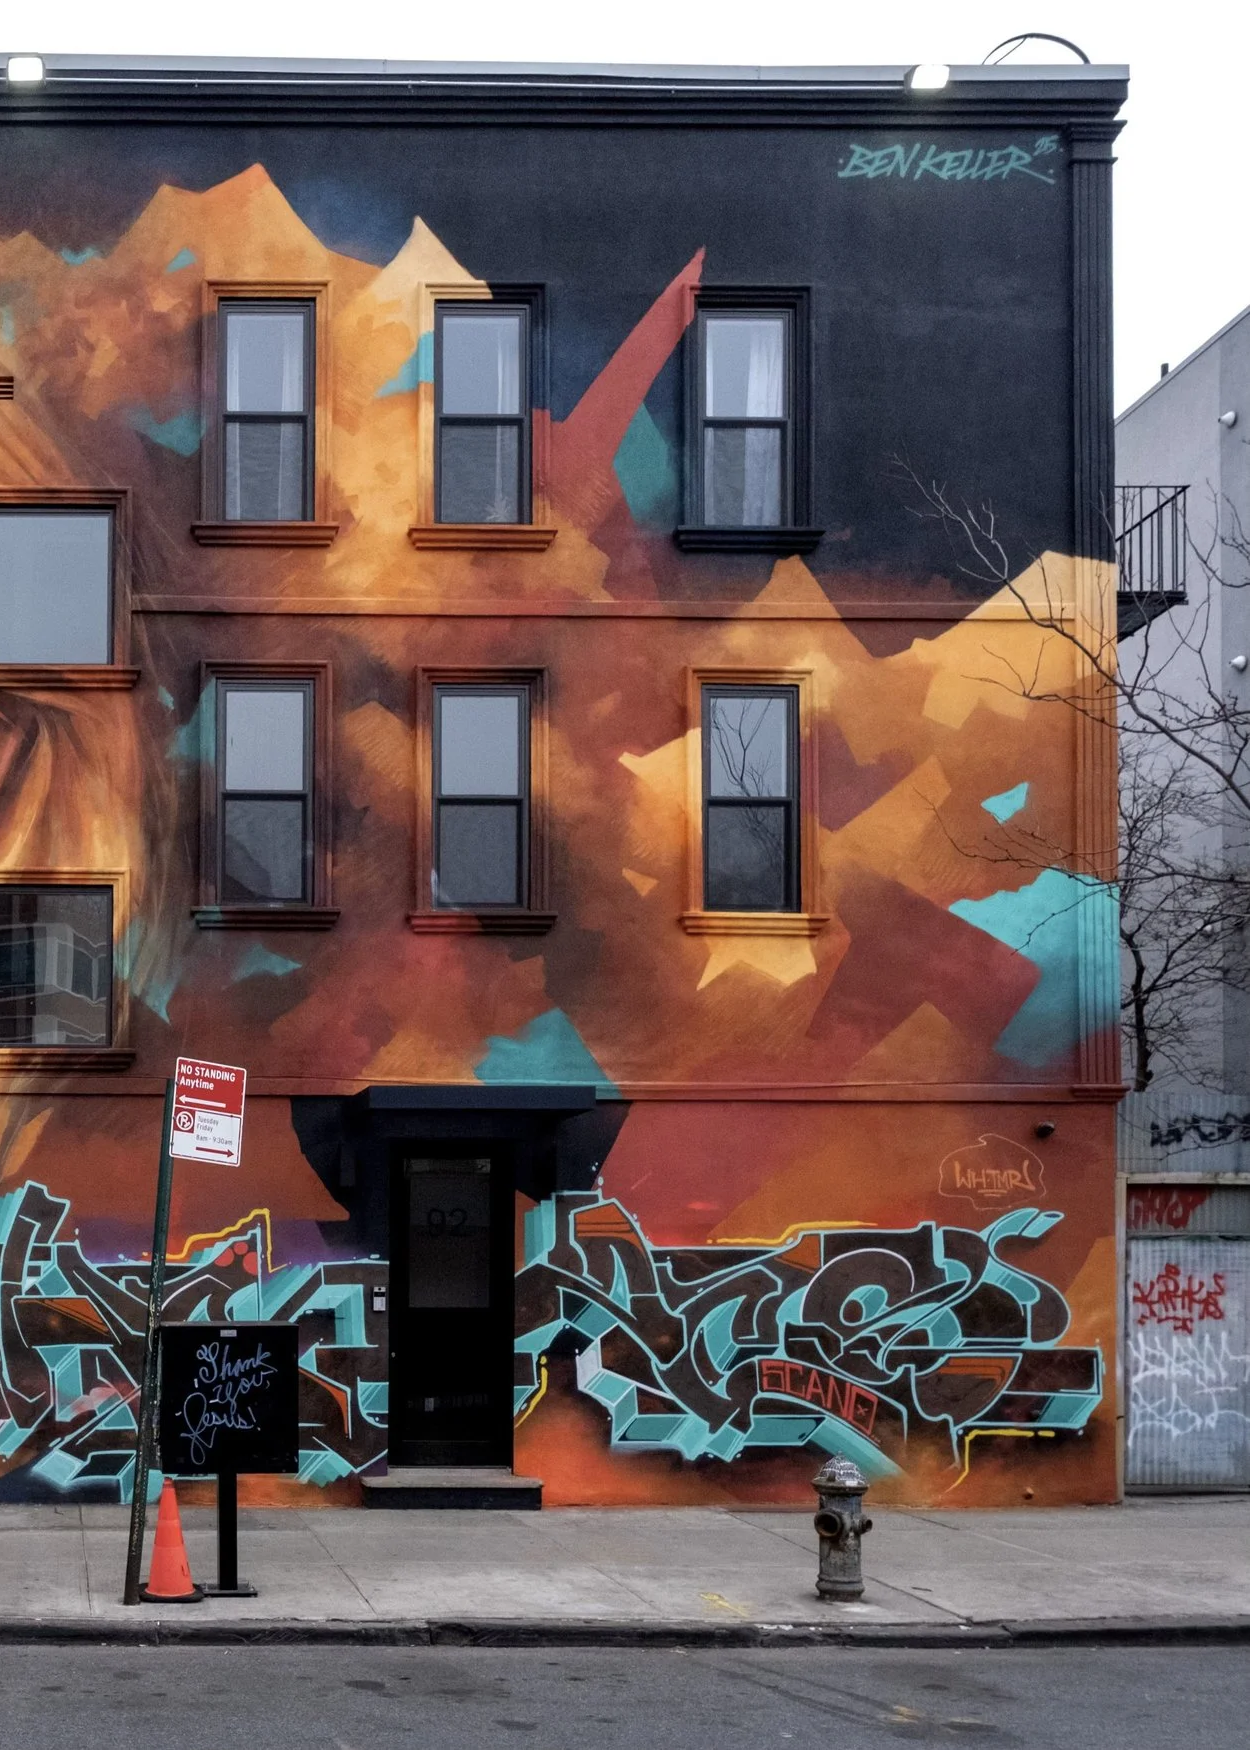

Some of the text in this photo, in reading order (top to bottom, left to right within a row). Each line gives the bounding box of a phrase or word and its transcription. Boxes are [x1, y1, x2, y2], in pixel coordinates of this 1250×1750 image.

[180, 1064, 236, 1082] NO STANDING
[179, 1076, 214, 1091] Anytime
[197, 1116, 219, 1126] Tuesday
[196, 1124, 213, 1133] Friday
[195, 1134, 208, 1142] 8am
[196, 1341, 278, 1384] Thank
